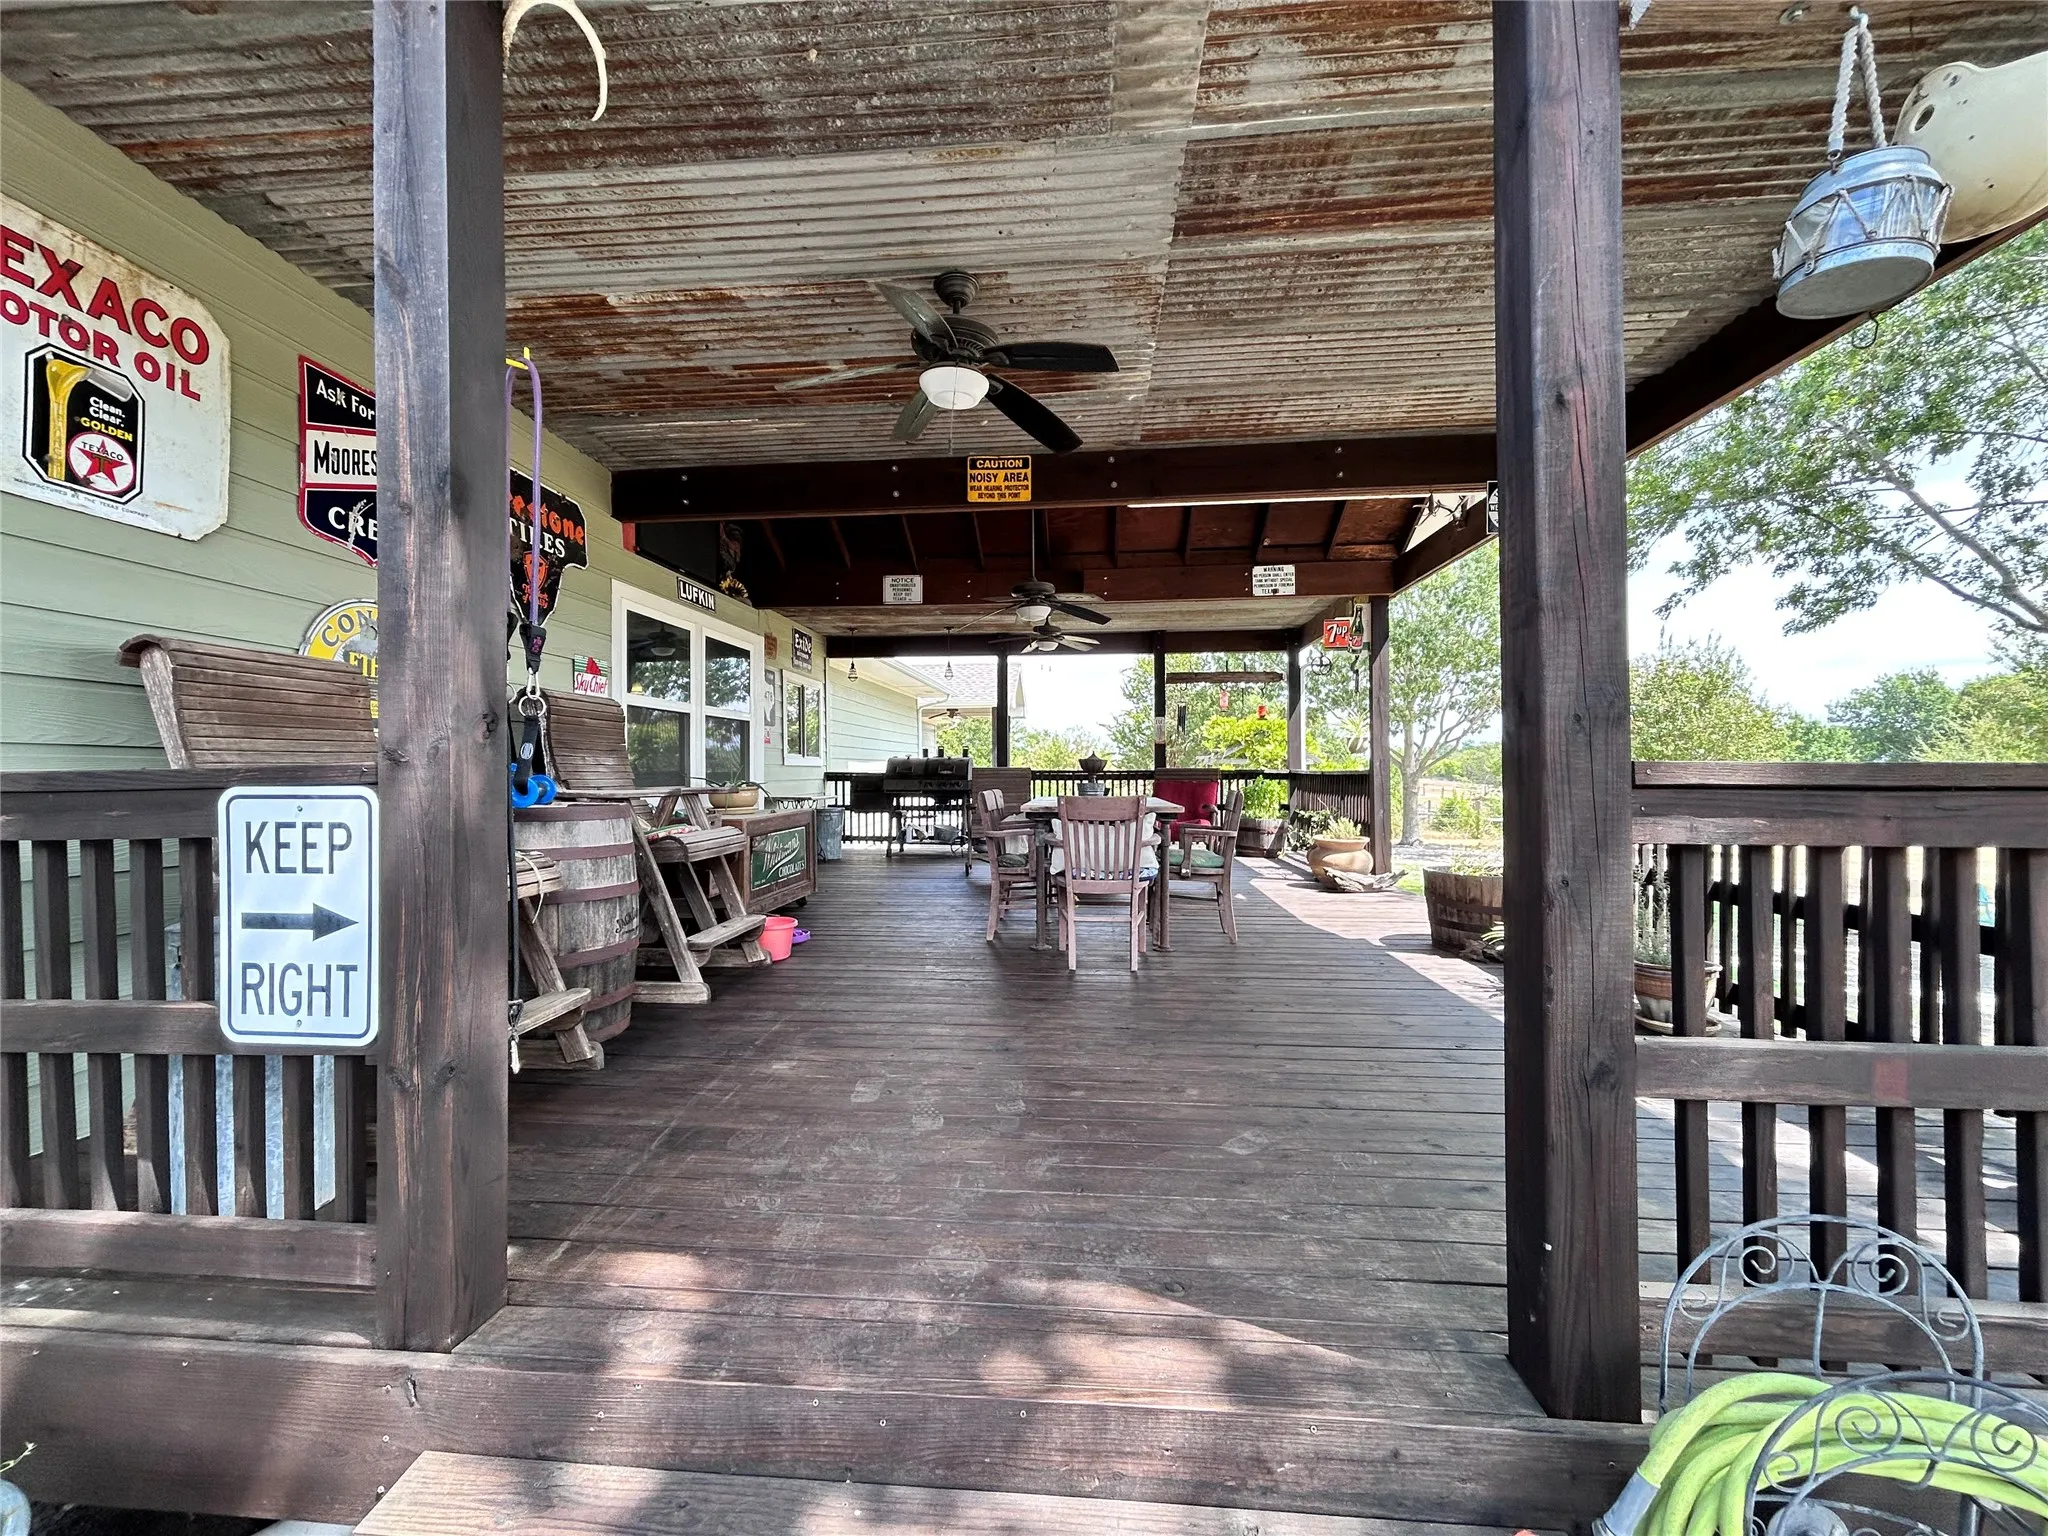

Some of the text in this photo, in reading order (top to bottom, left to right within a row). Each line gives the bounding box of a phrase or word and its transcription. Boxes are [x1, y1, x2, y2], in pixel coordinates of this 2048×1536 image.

[134, 351, 201, 402] OIL
[89, 396, 126, 418] Clean.
[316, 379, 375, 420] Ask For
[89, 406, 125, 427] Clear.
[80, 417, 133, 442] GOLDEN
[80, 441, 124, 461] TEXACO
[976, 459, 1023, 469] CAUTION
[969, 472, 1029, 483] NOISY AREA
[84, 497, 96, 505] THE
[100, 501, 119, 511] TEXAS
[121, 506, 149, 518] COMPANY
[679, 580, 715, 610] LUFKIN
[574, 672, 608, 695] Sky Chief
[245, 821, 352, 875] KEEP
[778, 860, 805, 877] CHOCOLATES
[241, 962, 358, 1018] RIGHT
